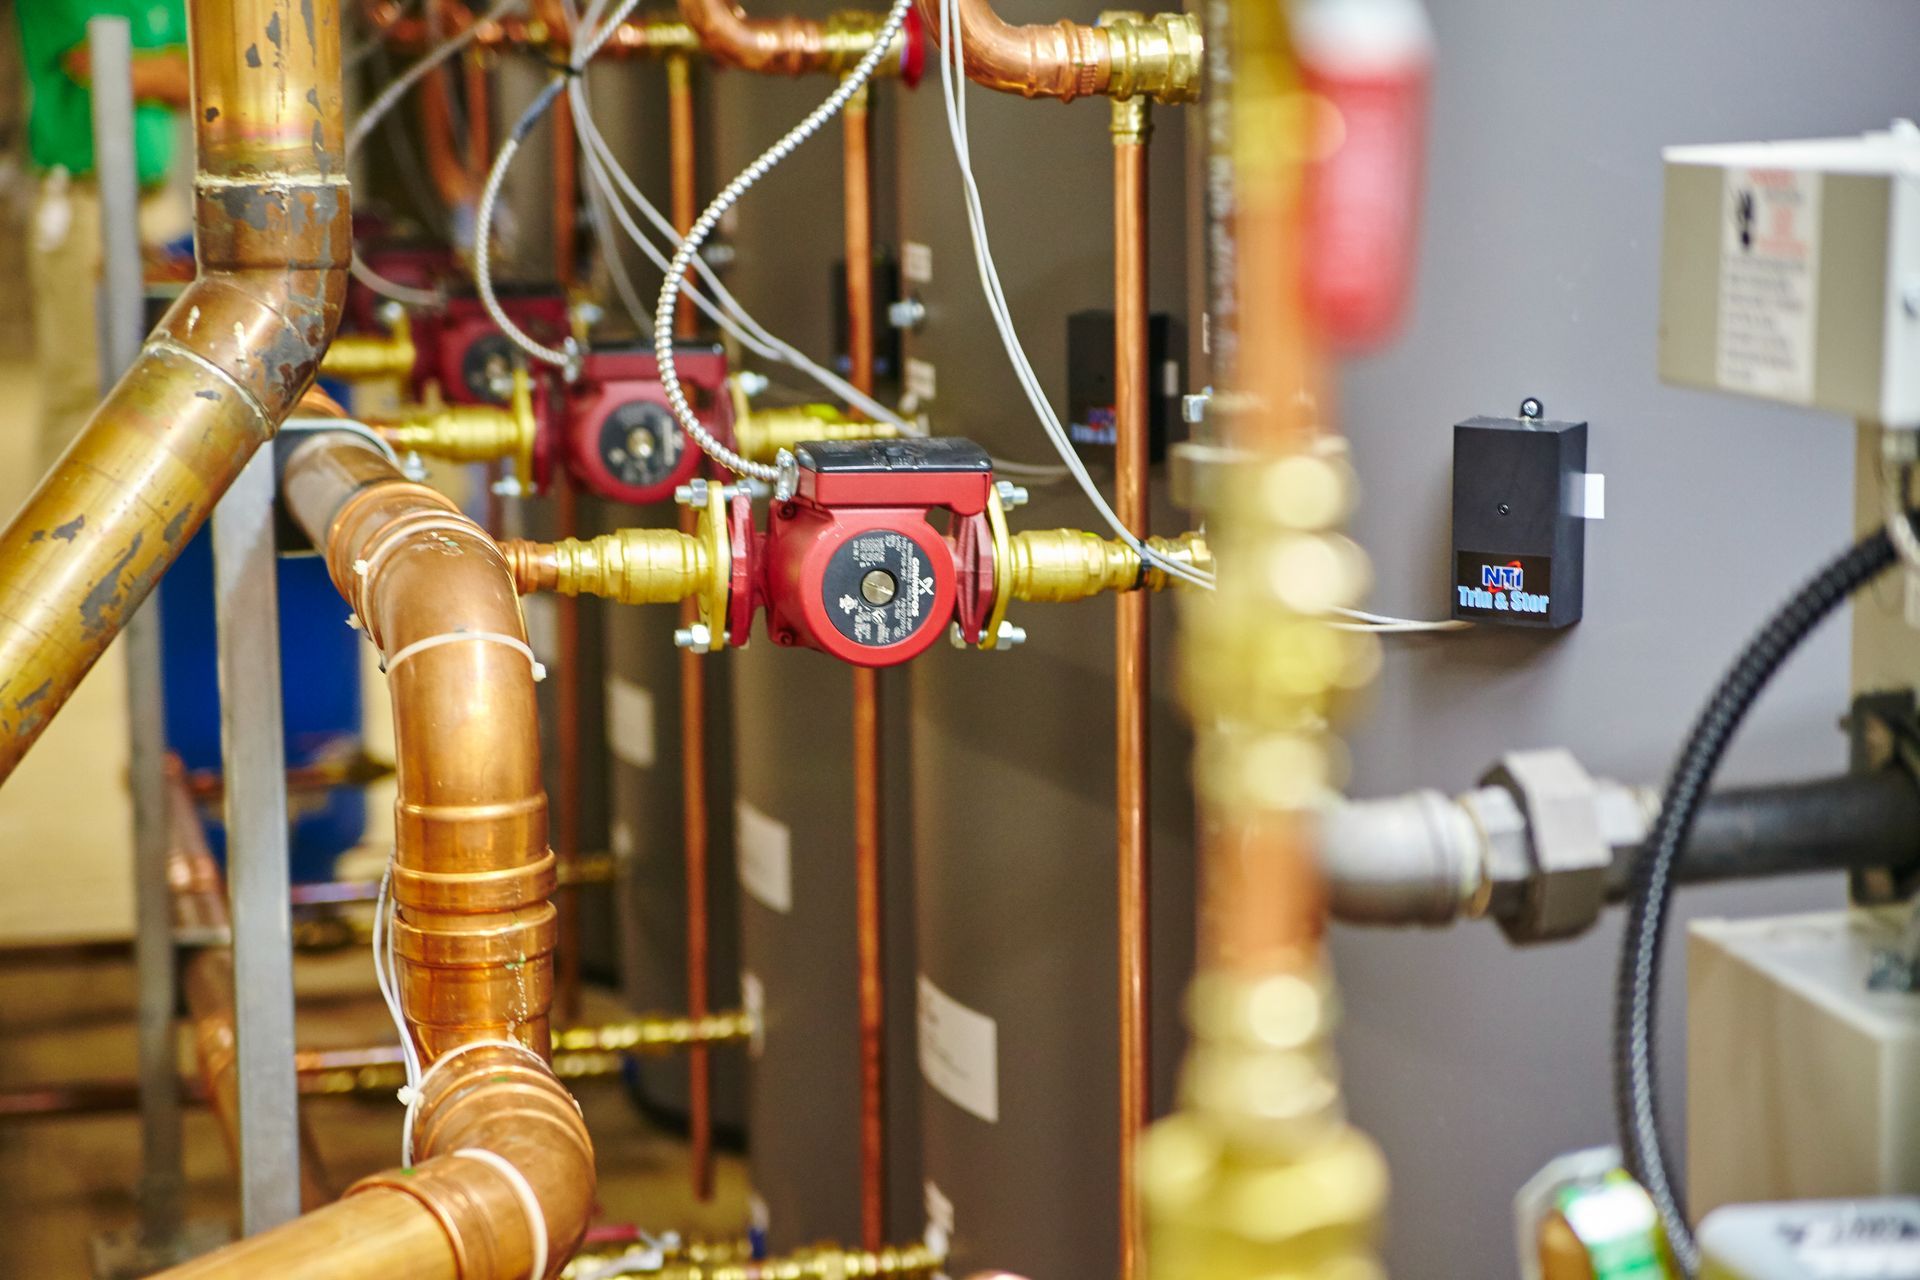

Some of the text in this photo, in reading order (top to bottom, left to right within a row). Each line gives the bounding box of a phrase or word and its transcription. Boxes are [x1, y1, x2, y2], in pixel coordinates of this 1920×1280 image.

[911, 557, 920, 617] GRUNDFOS
[1482, 565, 1523, 590] NTI
[1494, 592, 1509, 610] &
[1510, 590, 1549, 613] Stor
